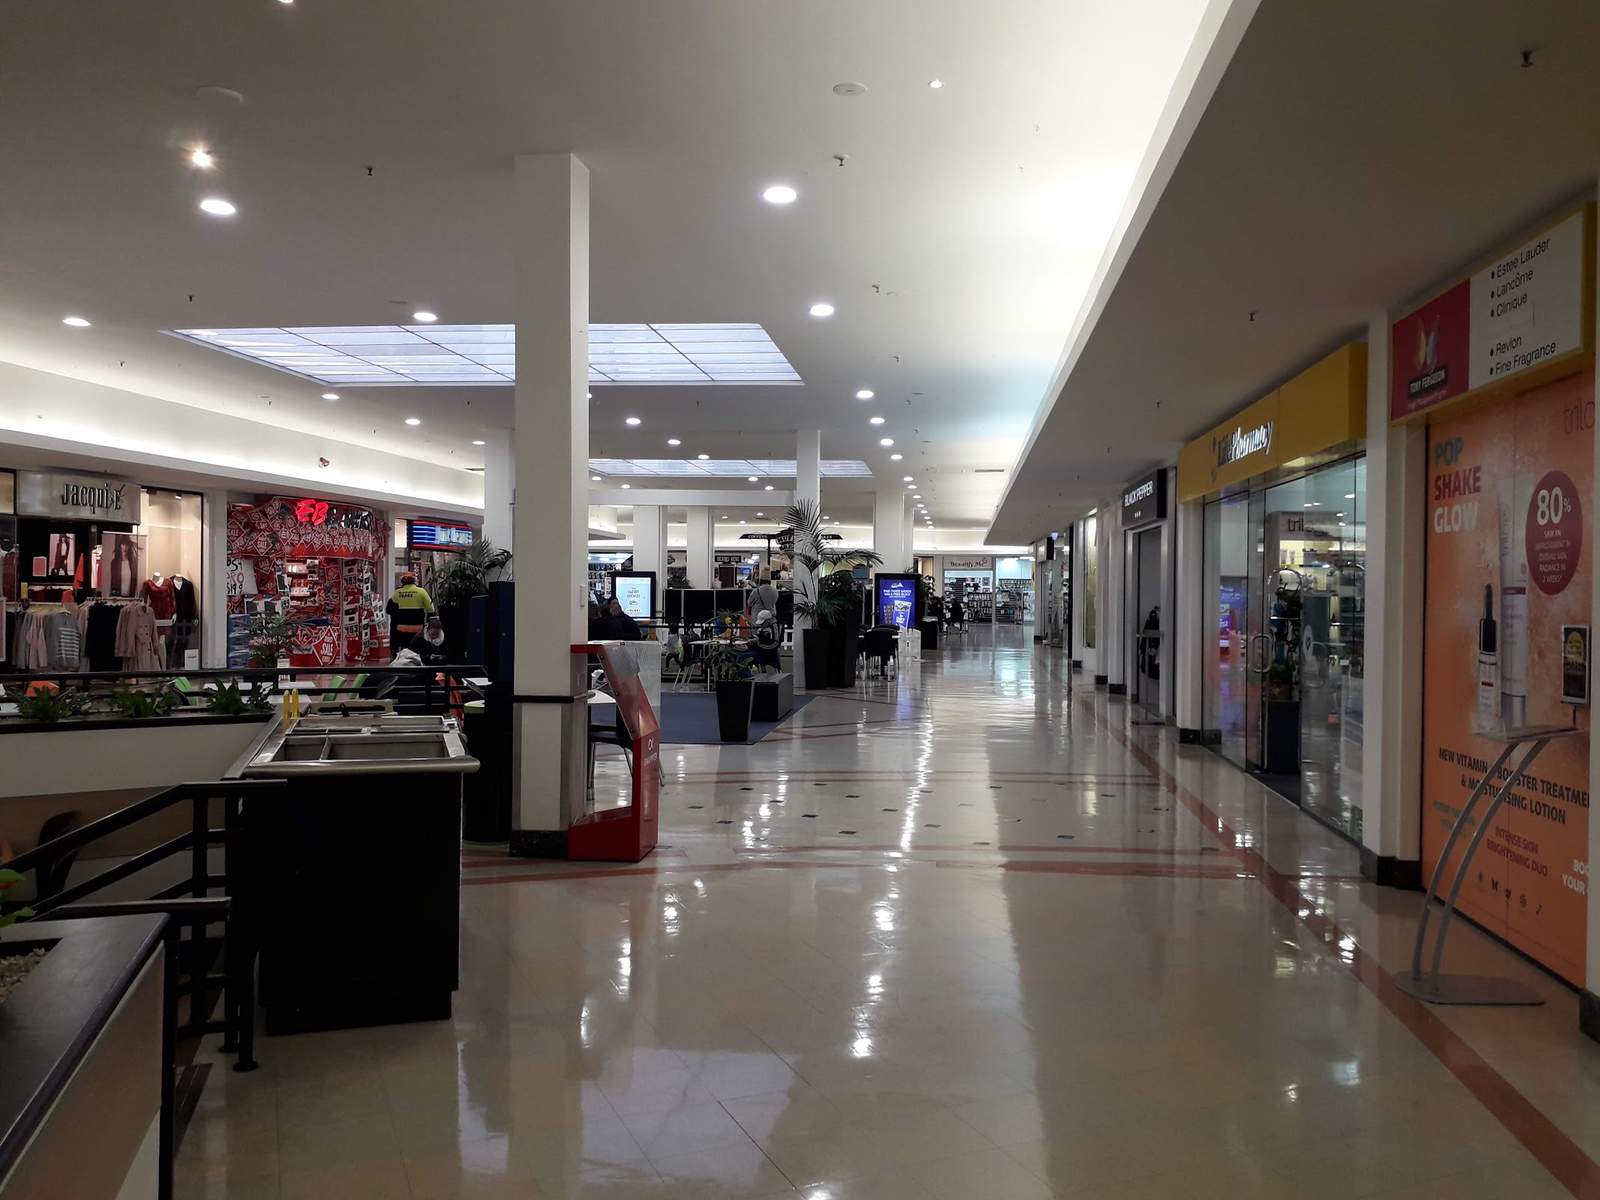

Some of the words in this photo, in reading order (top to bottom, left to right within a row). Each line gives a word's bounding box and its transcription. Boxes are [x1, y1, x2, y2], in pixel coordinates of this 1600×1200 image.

[1520, 239, 1550, 264] Lauder
[1496, 269, 1533, 297] Lancôme
[1496, 293, 1528, 317] Clinique
[1495, 360, 1512, 375] Fine
[1513, 342, 1556, 367] Fragrance
[1496, 335, 1522, 356] Revlon
[1434, 436, 1463, 466] POP
[1434, 465, 1482, 501] SHAKE
[296, 499, 329, 525] EB
[1434, 502, 1479, 533] GLOW
[1537, 486, 1571, 526] 80%
[1439, 747, 1455, 763] NEW
[1457, 753, 1488, 773] VITAMIN
[1497, 766, 1537, 791] BOSTER
[1461, 774, 1466, 787] &
[1530, 799, 1566, 824] LOTION
[1487, 839, 1530, 870] BRIGHTENING
[1532, 860, 1548, 877] DUO
[1561, 872, 1585, 895] YOUR
